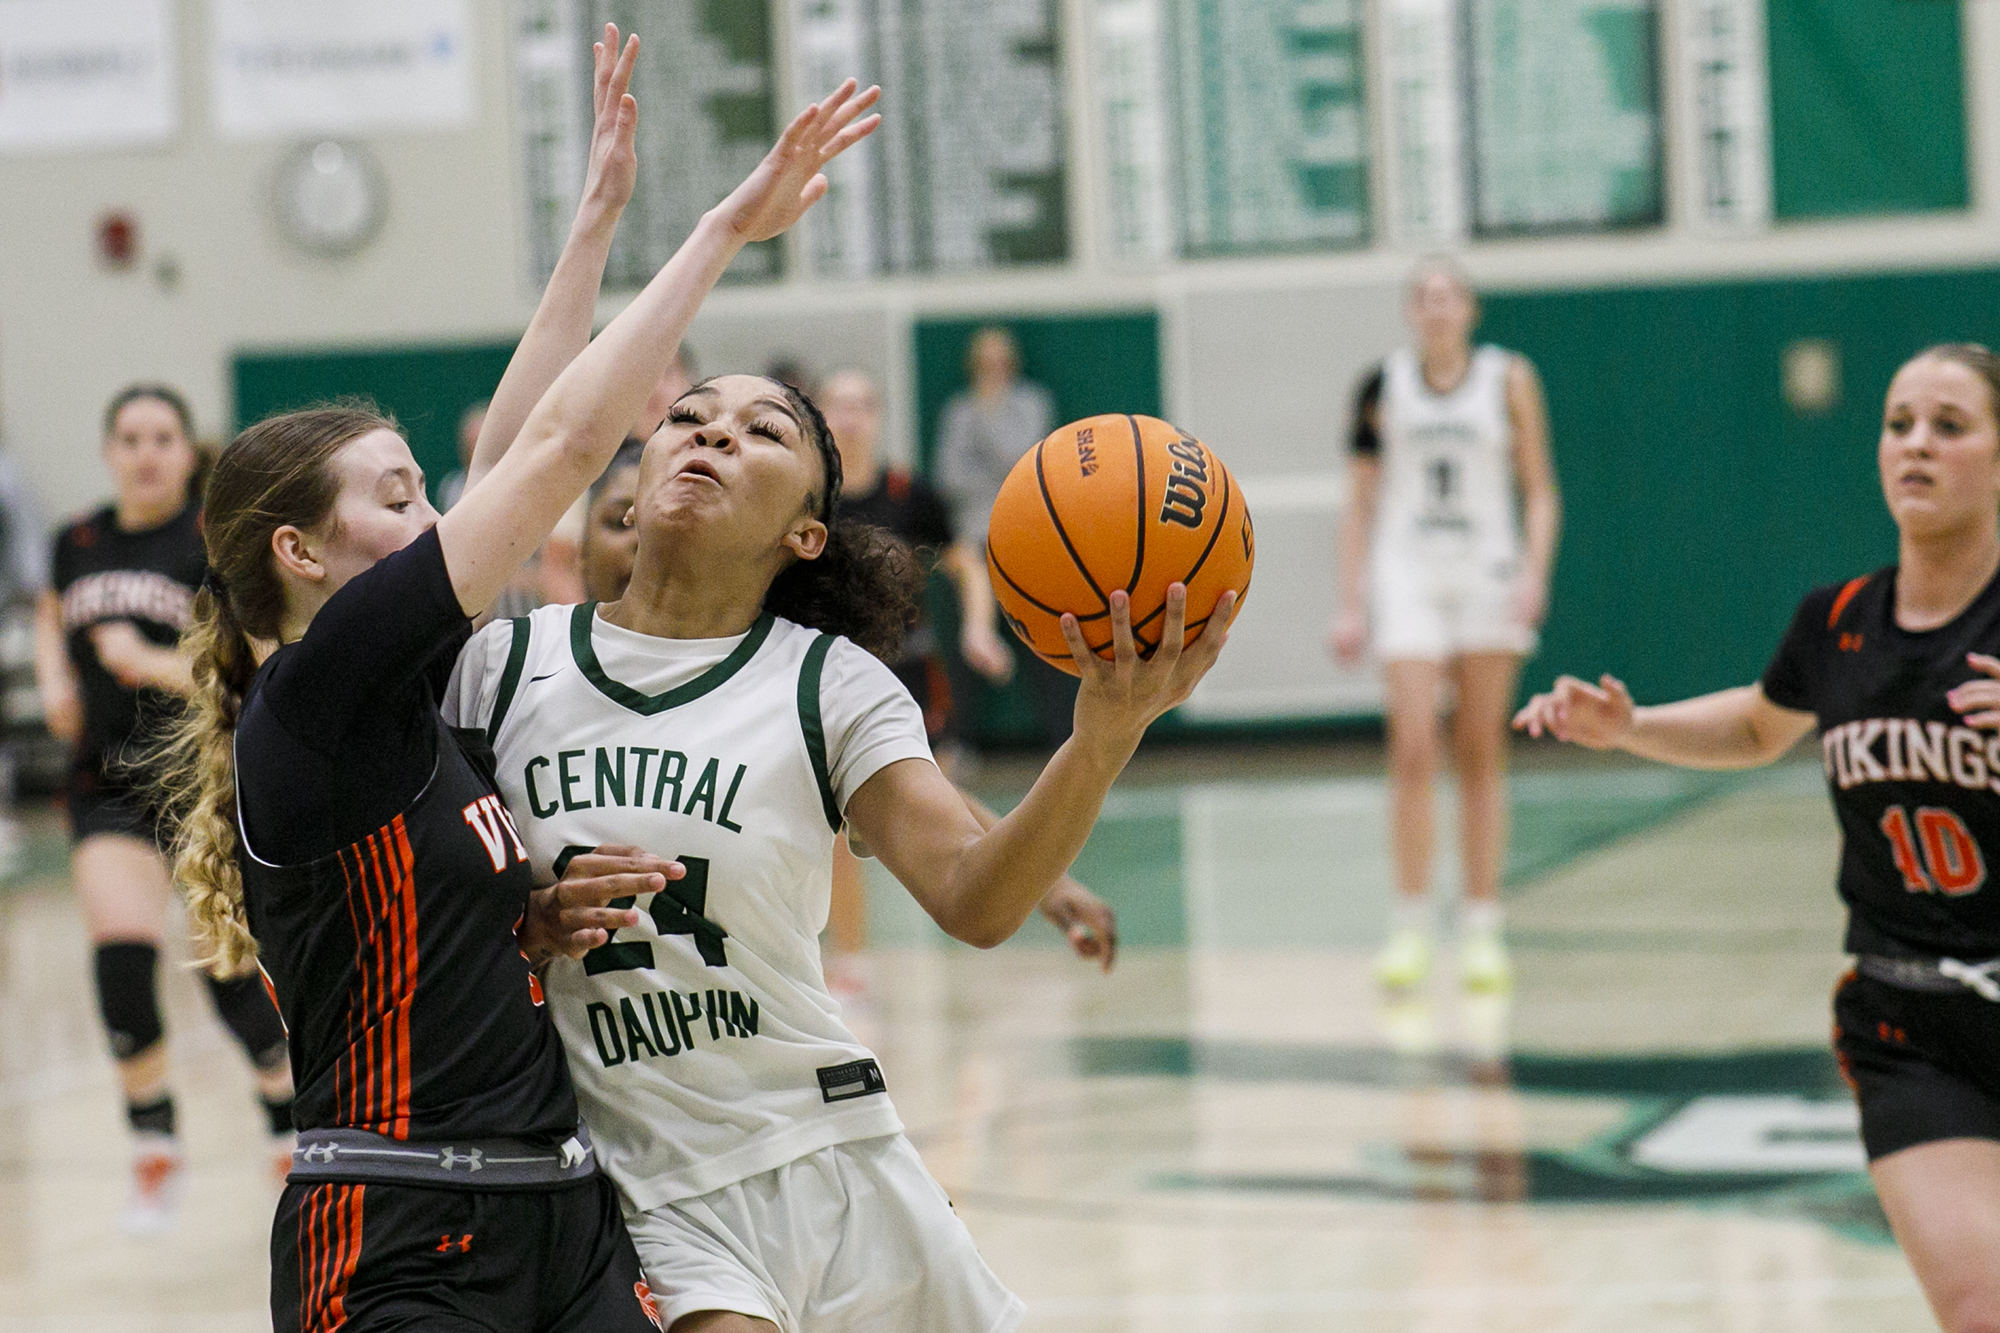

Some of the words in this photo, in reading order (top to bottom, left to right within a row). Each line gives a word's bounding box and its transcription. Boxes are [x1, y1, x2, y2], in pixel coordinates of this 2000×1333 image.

[1077, 428, 1096, 463] NFHS
[1159, 427, 1209, 530] Wils
[524, 746, 747, 834] CENTRAL
[1879, 804, 1987, 896] 10
[552, 845, 729, 977] 24
